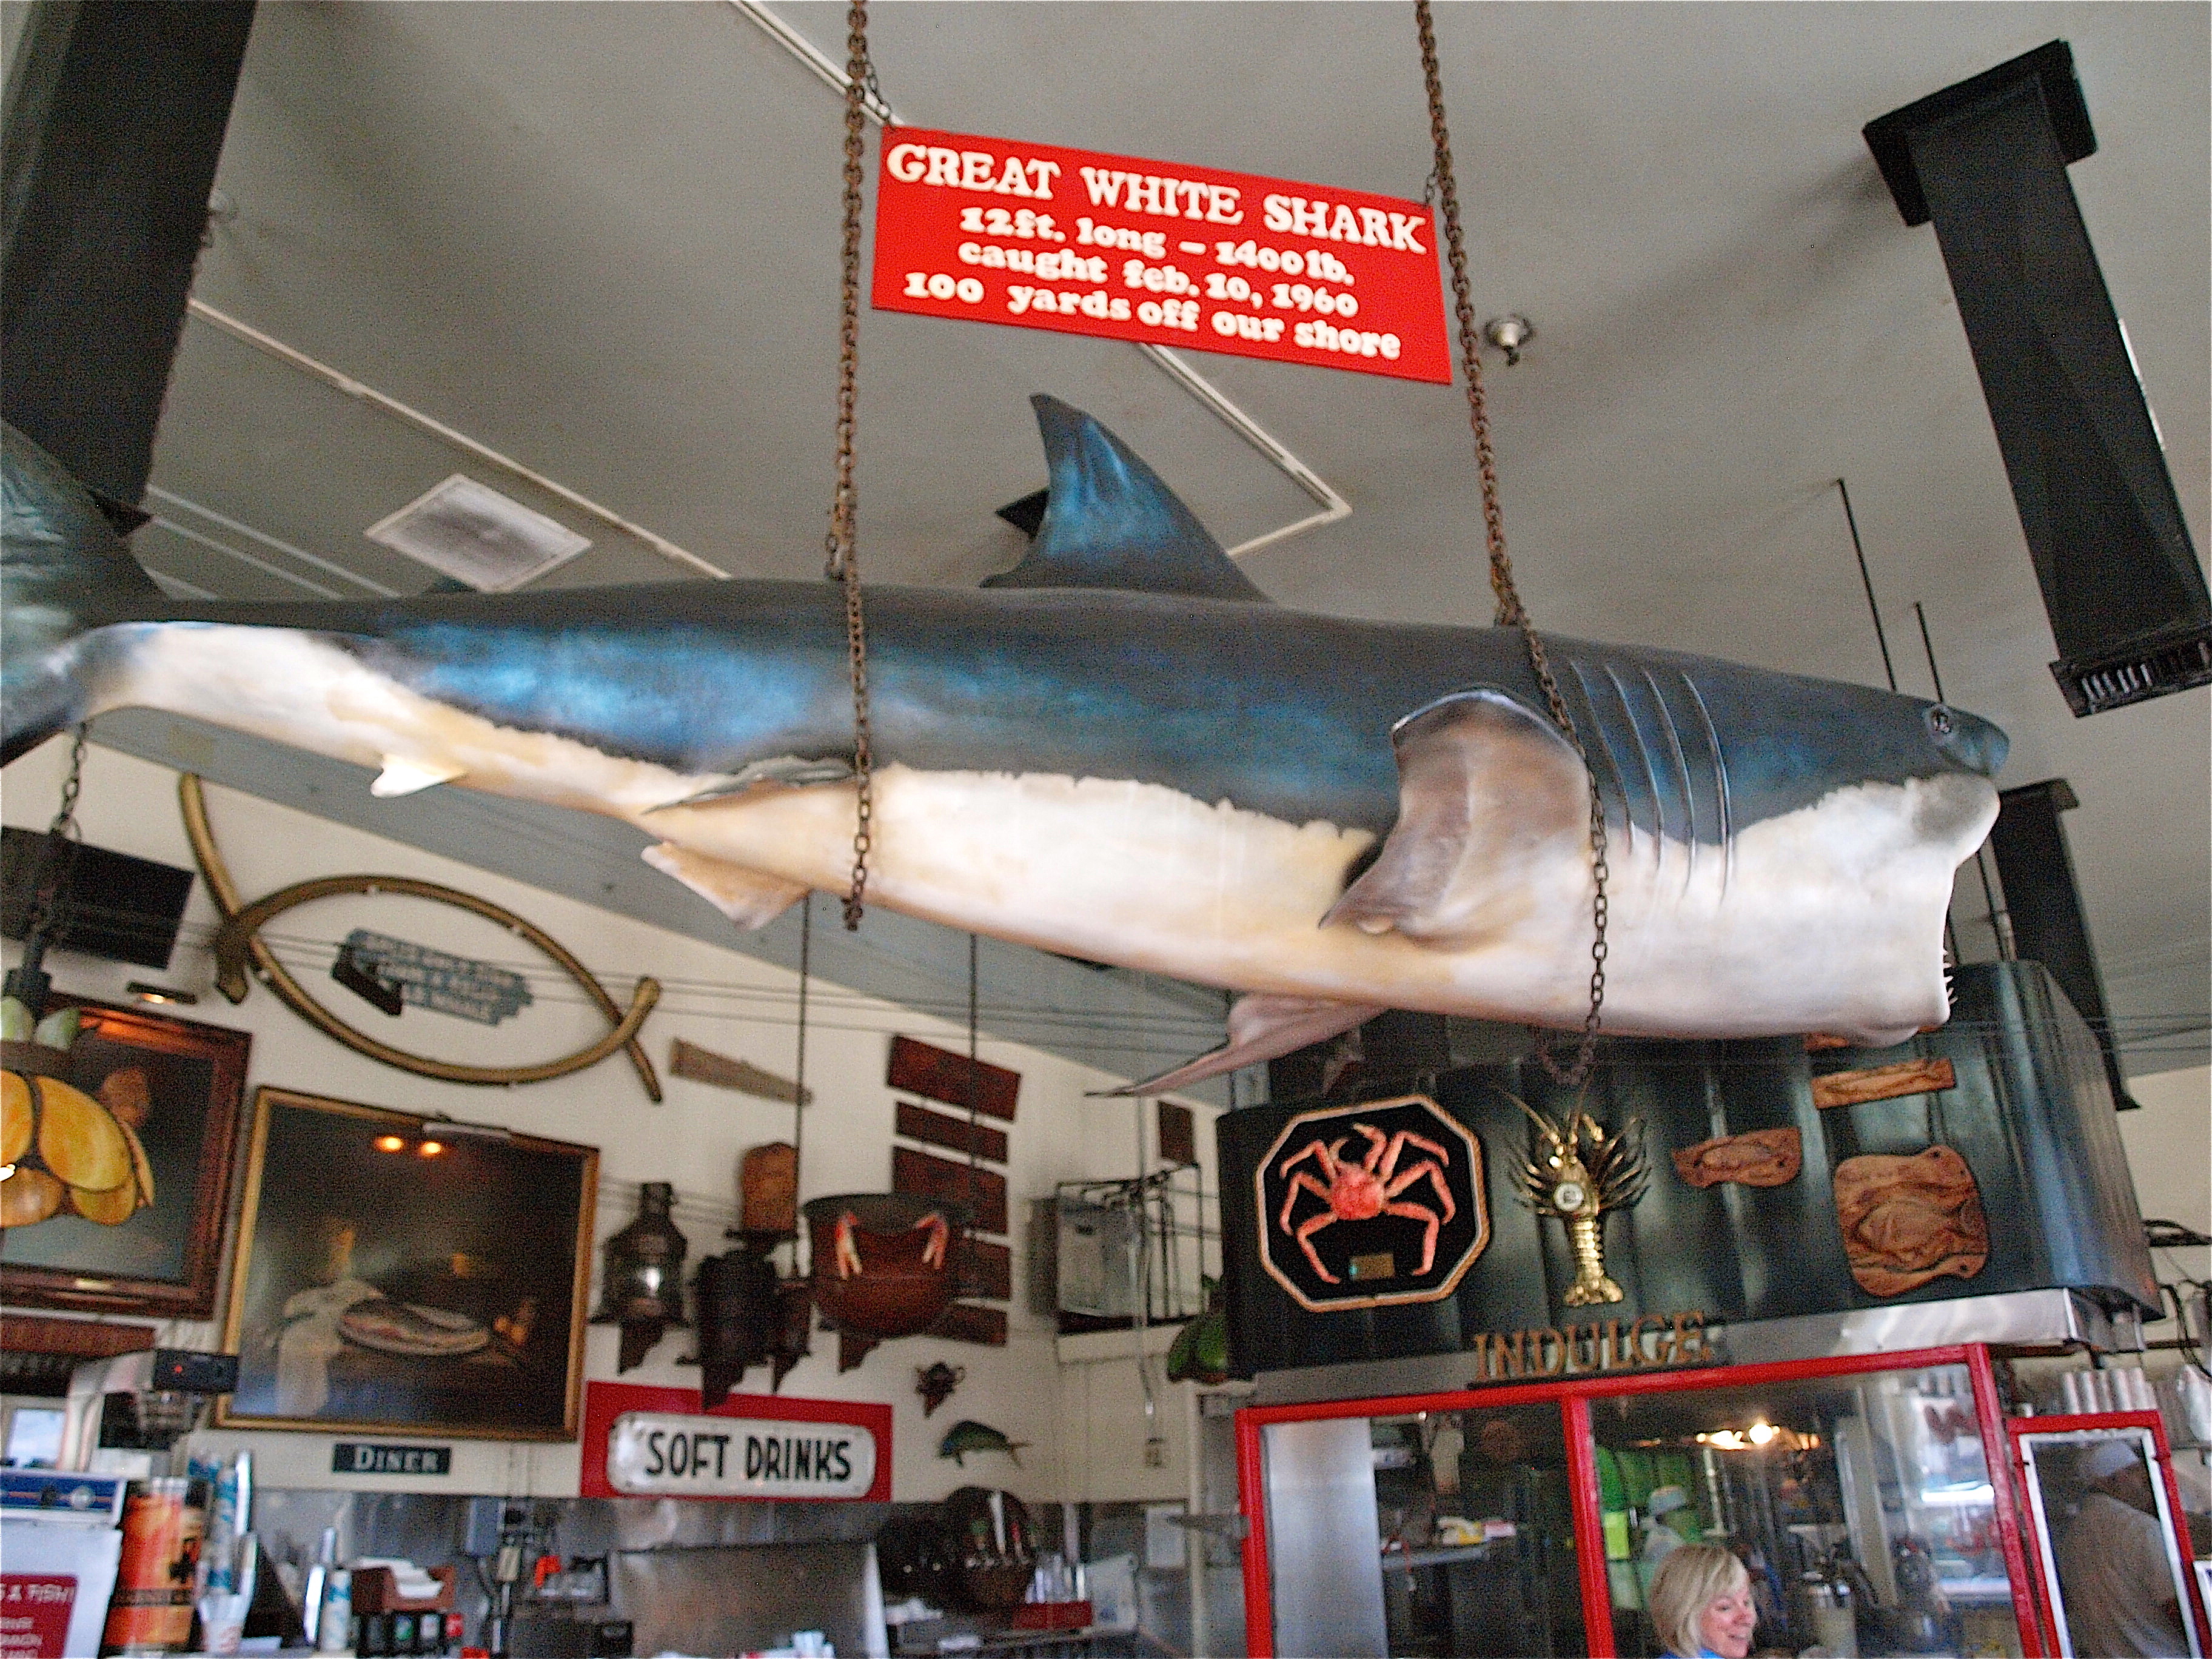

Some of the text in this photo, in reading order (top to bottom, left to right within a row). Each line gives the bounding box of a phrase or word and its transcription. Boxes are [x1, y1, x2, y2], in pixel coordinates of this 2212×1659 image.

[886, 143, 1427, 255] GREAT WHITE SHARK
[959, 207, 1066, 243] 12ft.
[1076, 217, 1167, 260] long
[903, 272, 1401, 360] 100 yards off our shore
[957, 241, 1359, 317] caught feb. 10, 1960
[645, 1430, 851, 1481] SOFT DRINKS
